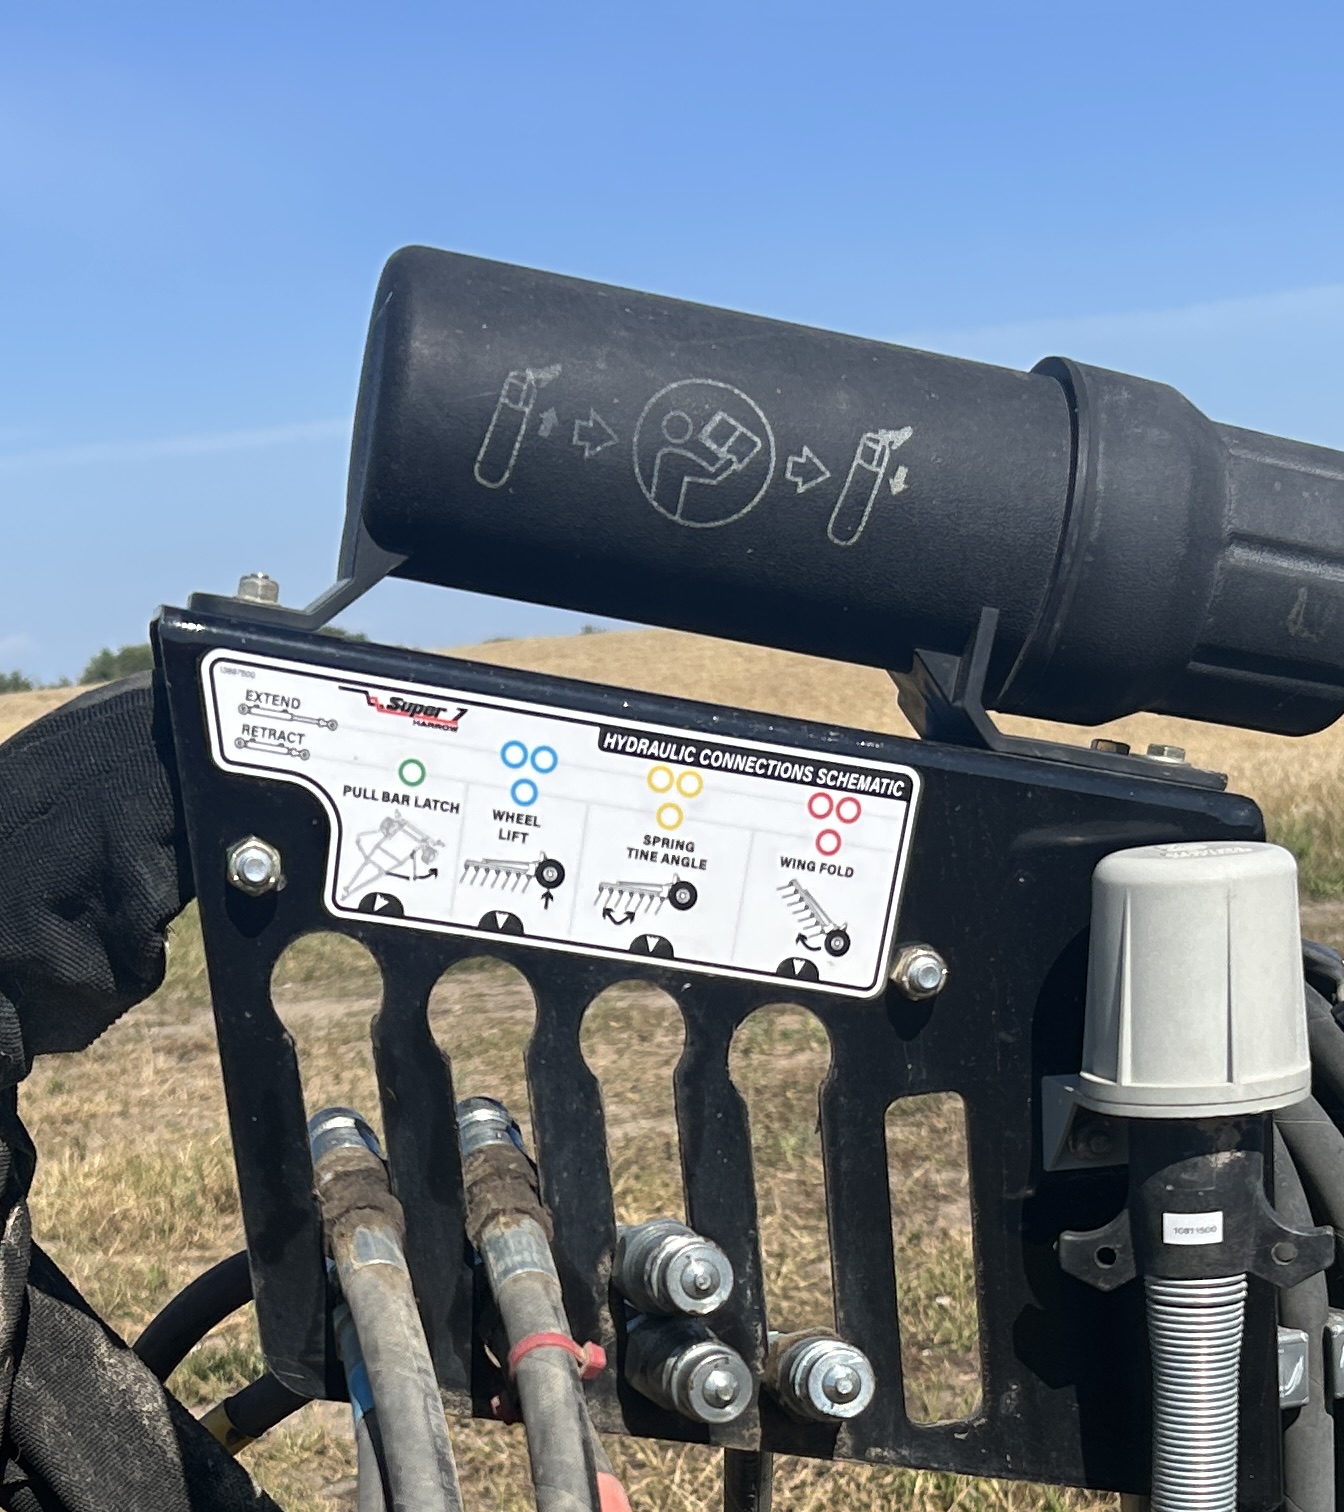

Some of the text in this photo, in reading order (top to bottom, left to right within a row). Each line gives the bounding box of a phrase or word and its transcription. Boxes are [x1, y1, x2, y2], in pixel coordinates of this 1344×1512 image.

[244, 688, 301, 710] EXTEND
[386, 695, 468, 723] Super 7
[240, 722, 306, 745] RETRACT
[412, 719, 458, 732] HARROW
[603, 732, 905, 797] HYDRAULIC CONNECTIONS SCHEMATIC
[342, 784, 459, 814] PULL BAR LATCH
[492, 808, 540, 828] WHEEL
[498, 828, 529, 844] LIFT
[642, 834, 695, 853] SPRING
[627, 847, 707, 870] TINE ANGLE
[779, 855, 855, 878] WING FOLD
